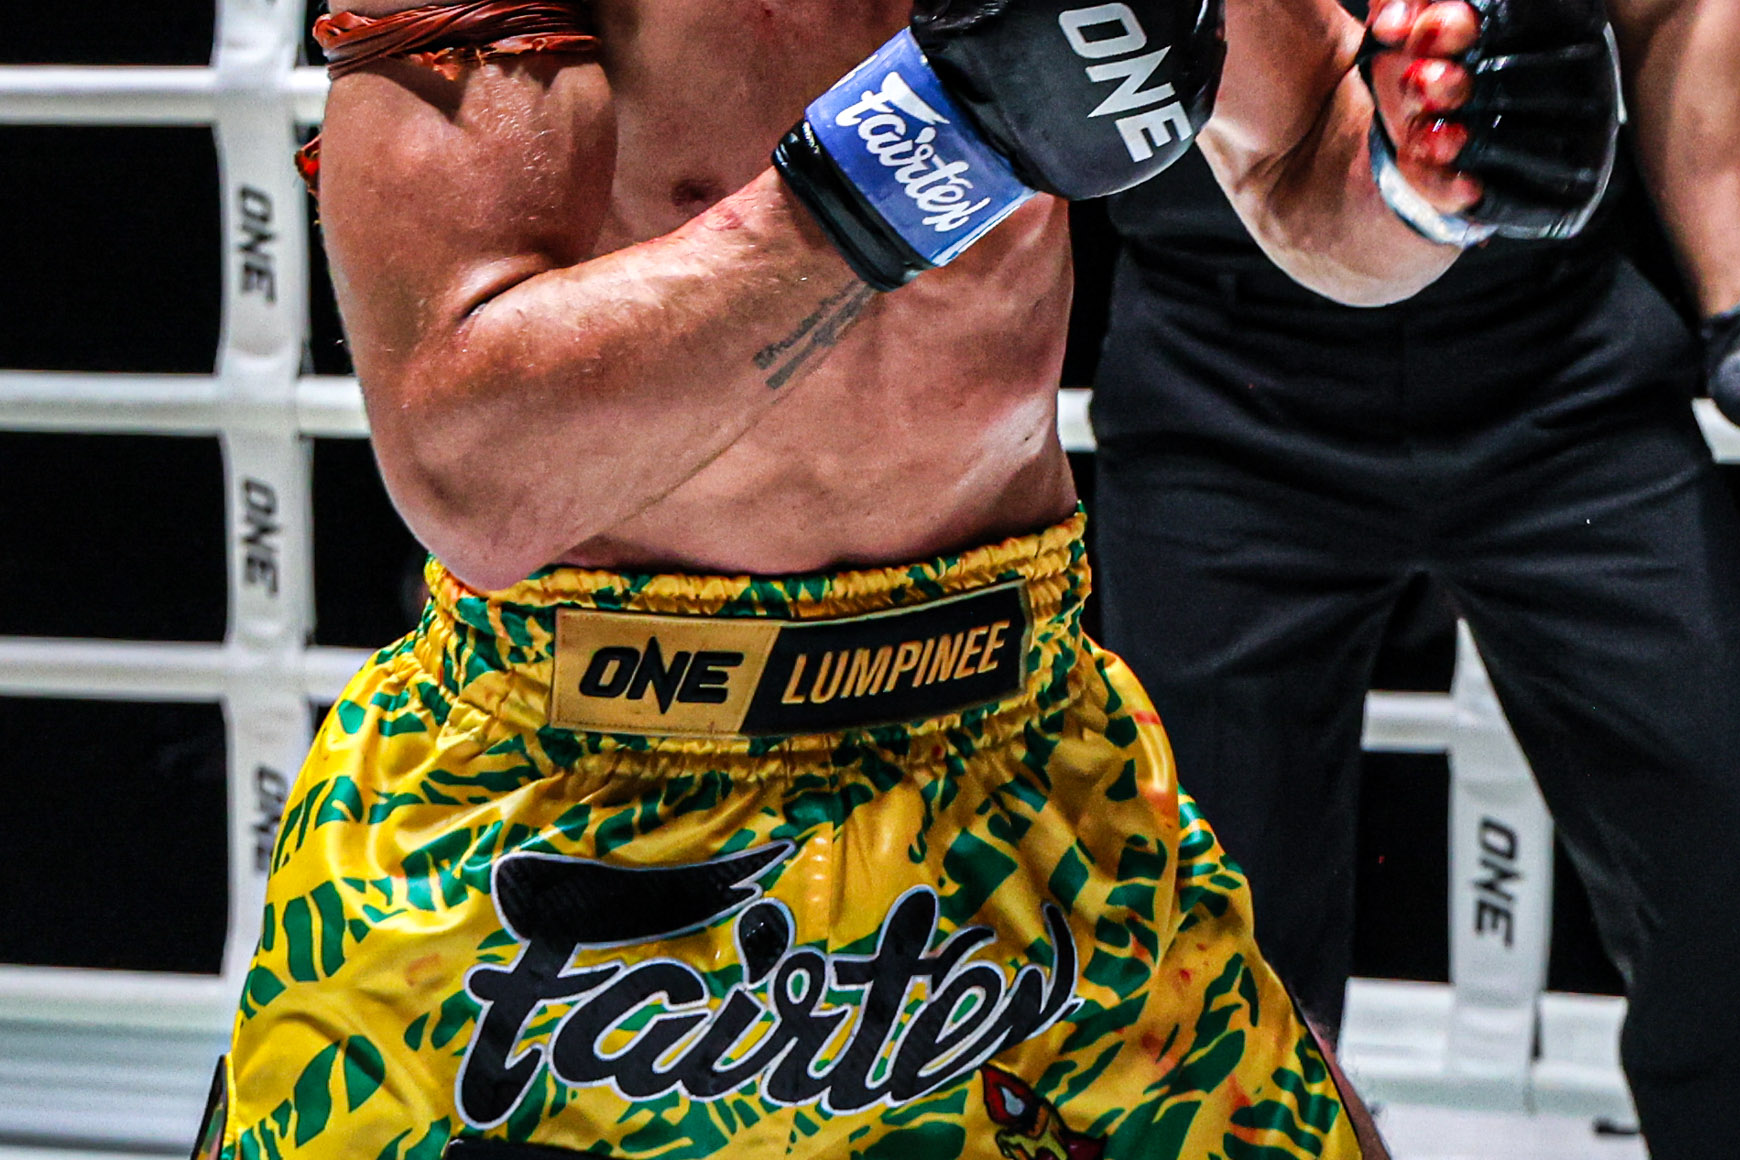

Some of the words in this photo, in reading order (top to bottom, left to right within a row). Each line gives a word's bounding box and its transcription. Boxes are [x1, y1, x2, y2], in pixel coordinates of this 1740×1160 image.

[1057, 2, 1193, 163] ONE
[835, 71, 990, 232] Fairtex
[239, 185, 276, 304] ONE
[240, 478, 280, 598] ONE
[578, 636, 745, 715] ONE
[781, 620, 1011, 705] LUMPINEE
[1470, 815, 1525, 950] ONE
